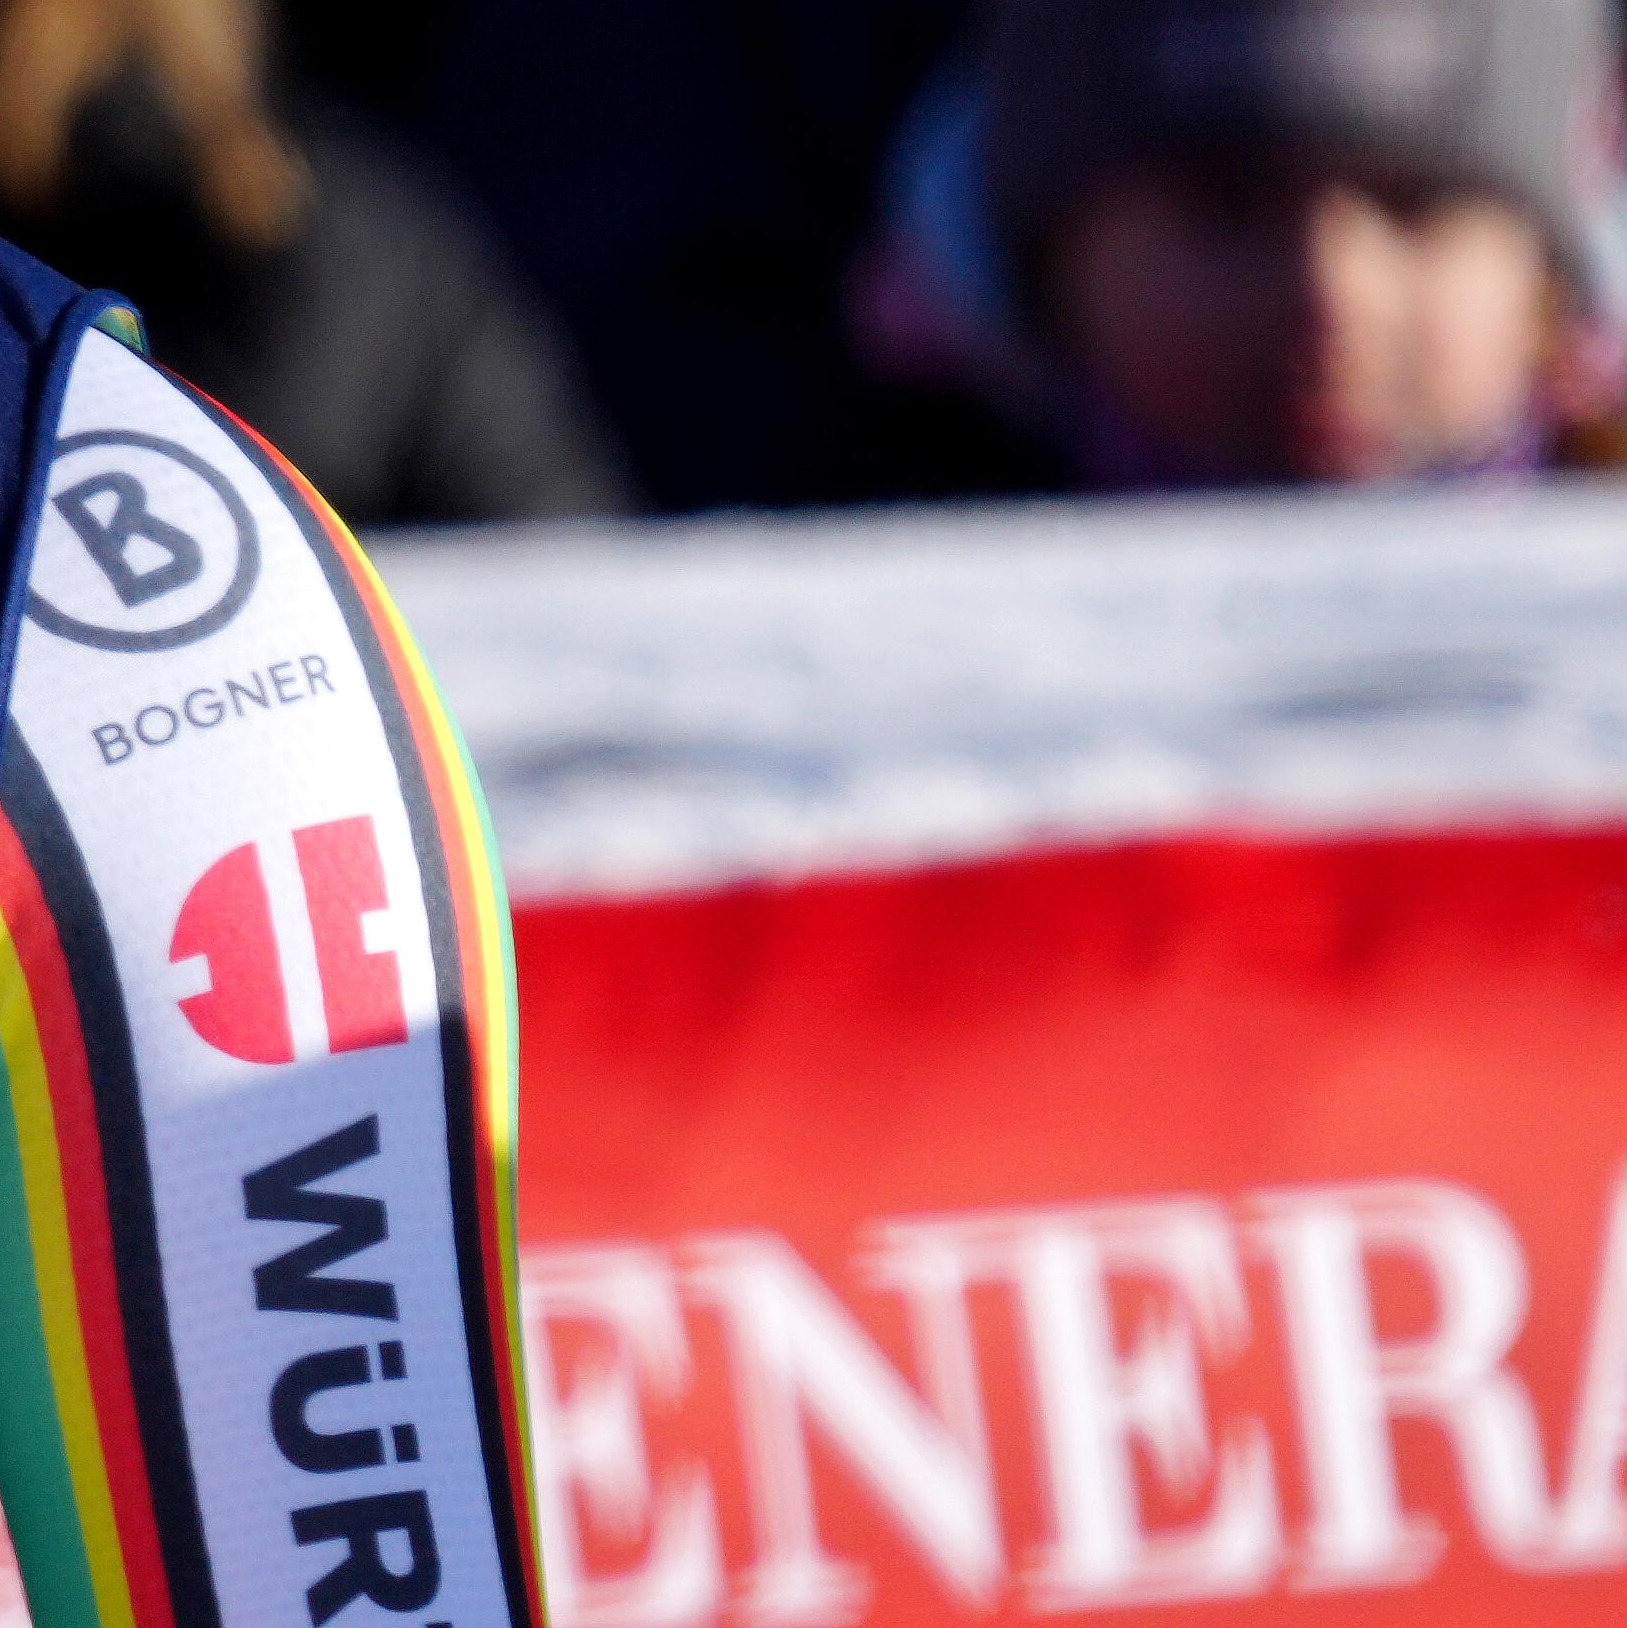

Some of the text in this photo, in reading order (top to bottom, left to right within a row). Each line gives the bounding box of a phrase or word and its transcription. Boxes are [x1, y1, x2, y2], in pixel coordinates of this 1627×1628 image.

[91, 654, 335, 766] BOGNER
[242, 1112, 453, 1628] WÜR
[519, 1174, 1627, 1626] ENER
